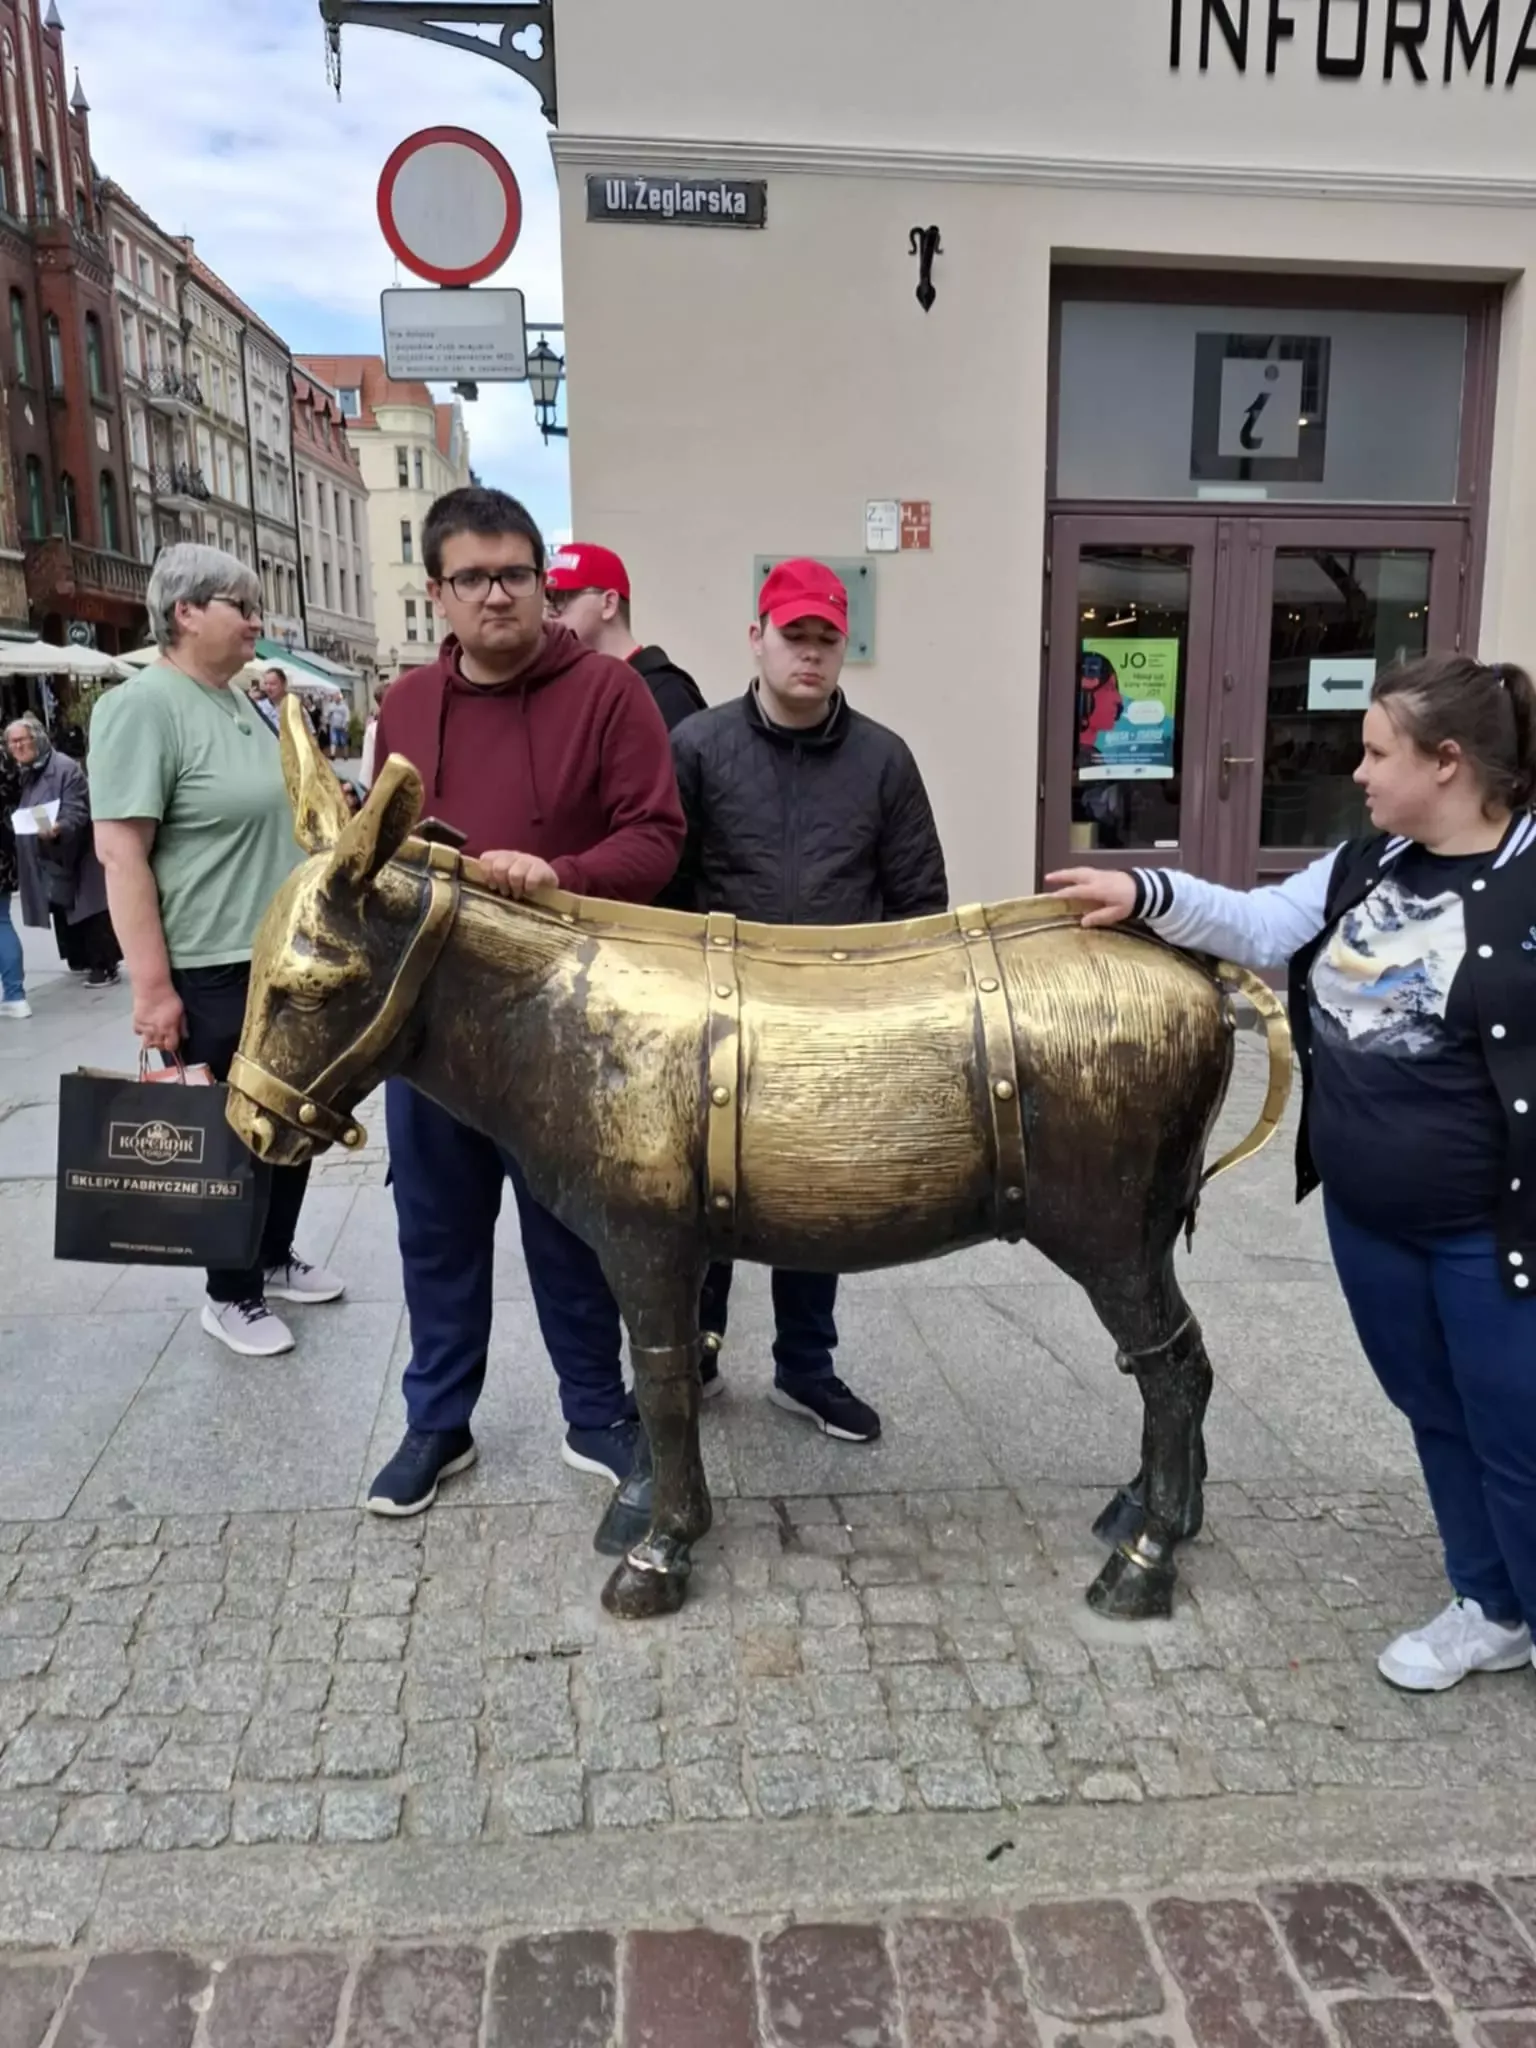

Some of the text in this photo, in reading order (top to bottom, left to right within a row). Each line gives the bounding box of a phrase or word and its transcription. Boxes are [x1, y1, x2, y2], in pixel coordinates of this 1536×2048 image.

[71, 1174, 199, 1195] SKLEPY FABRYCZNE
[208, 1184, 237, 1197] 1763
